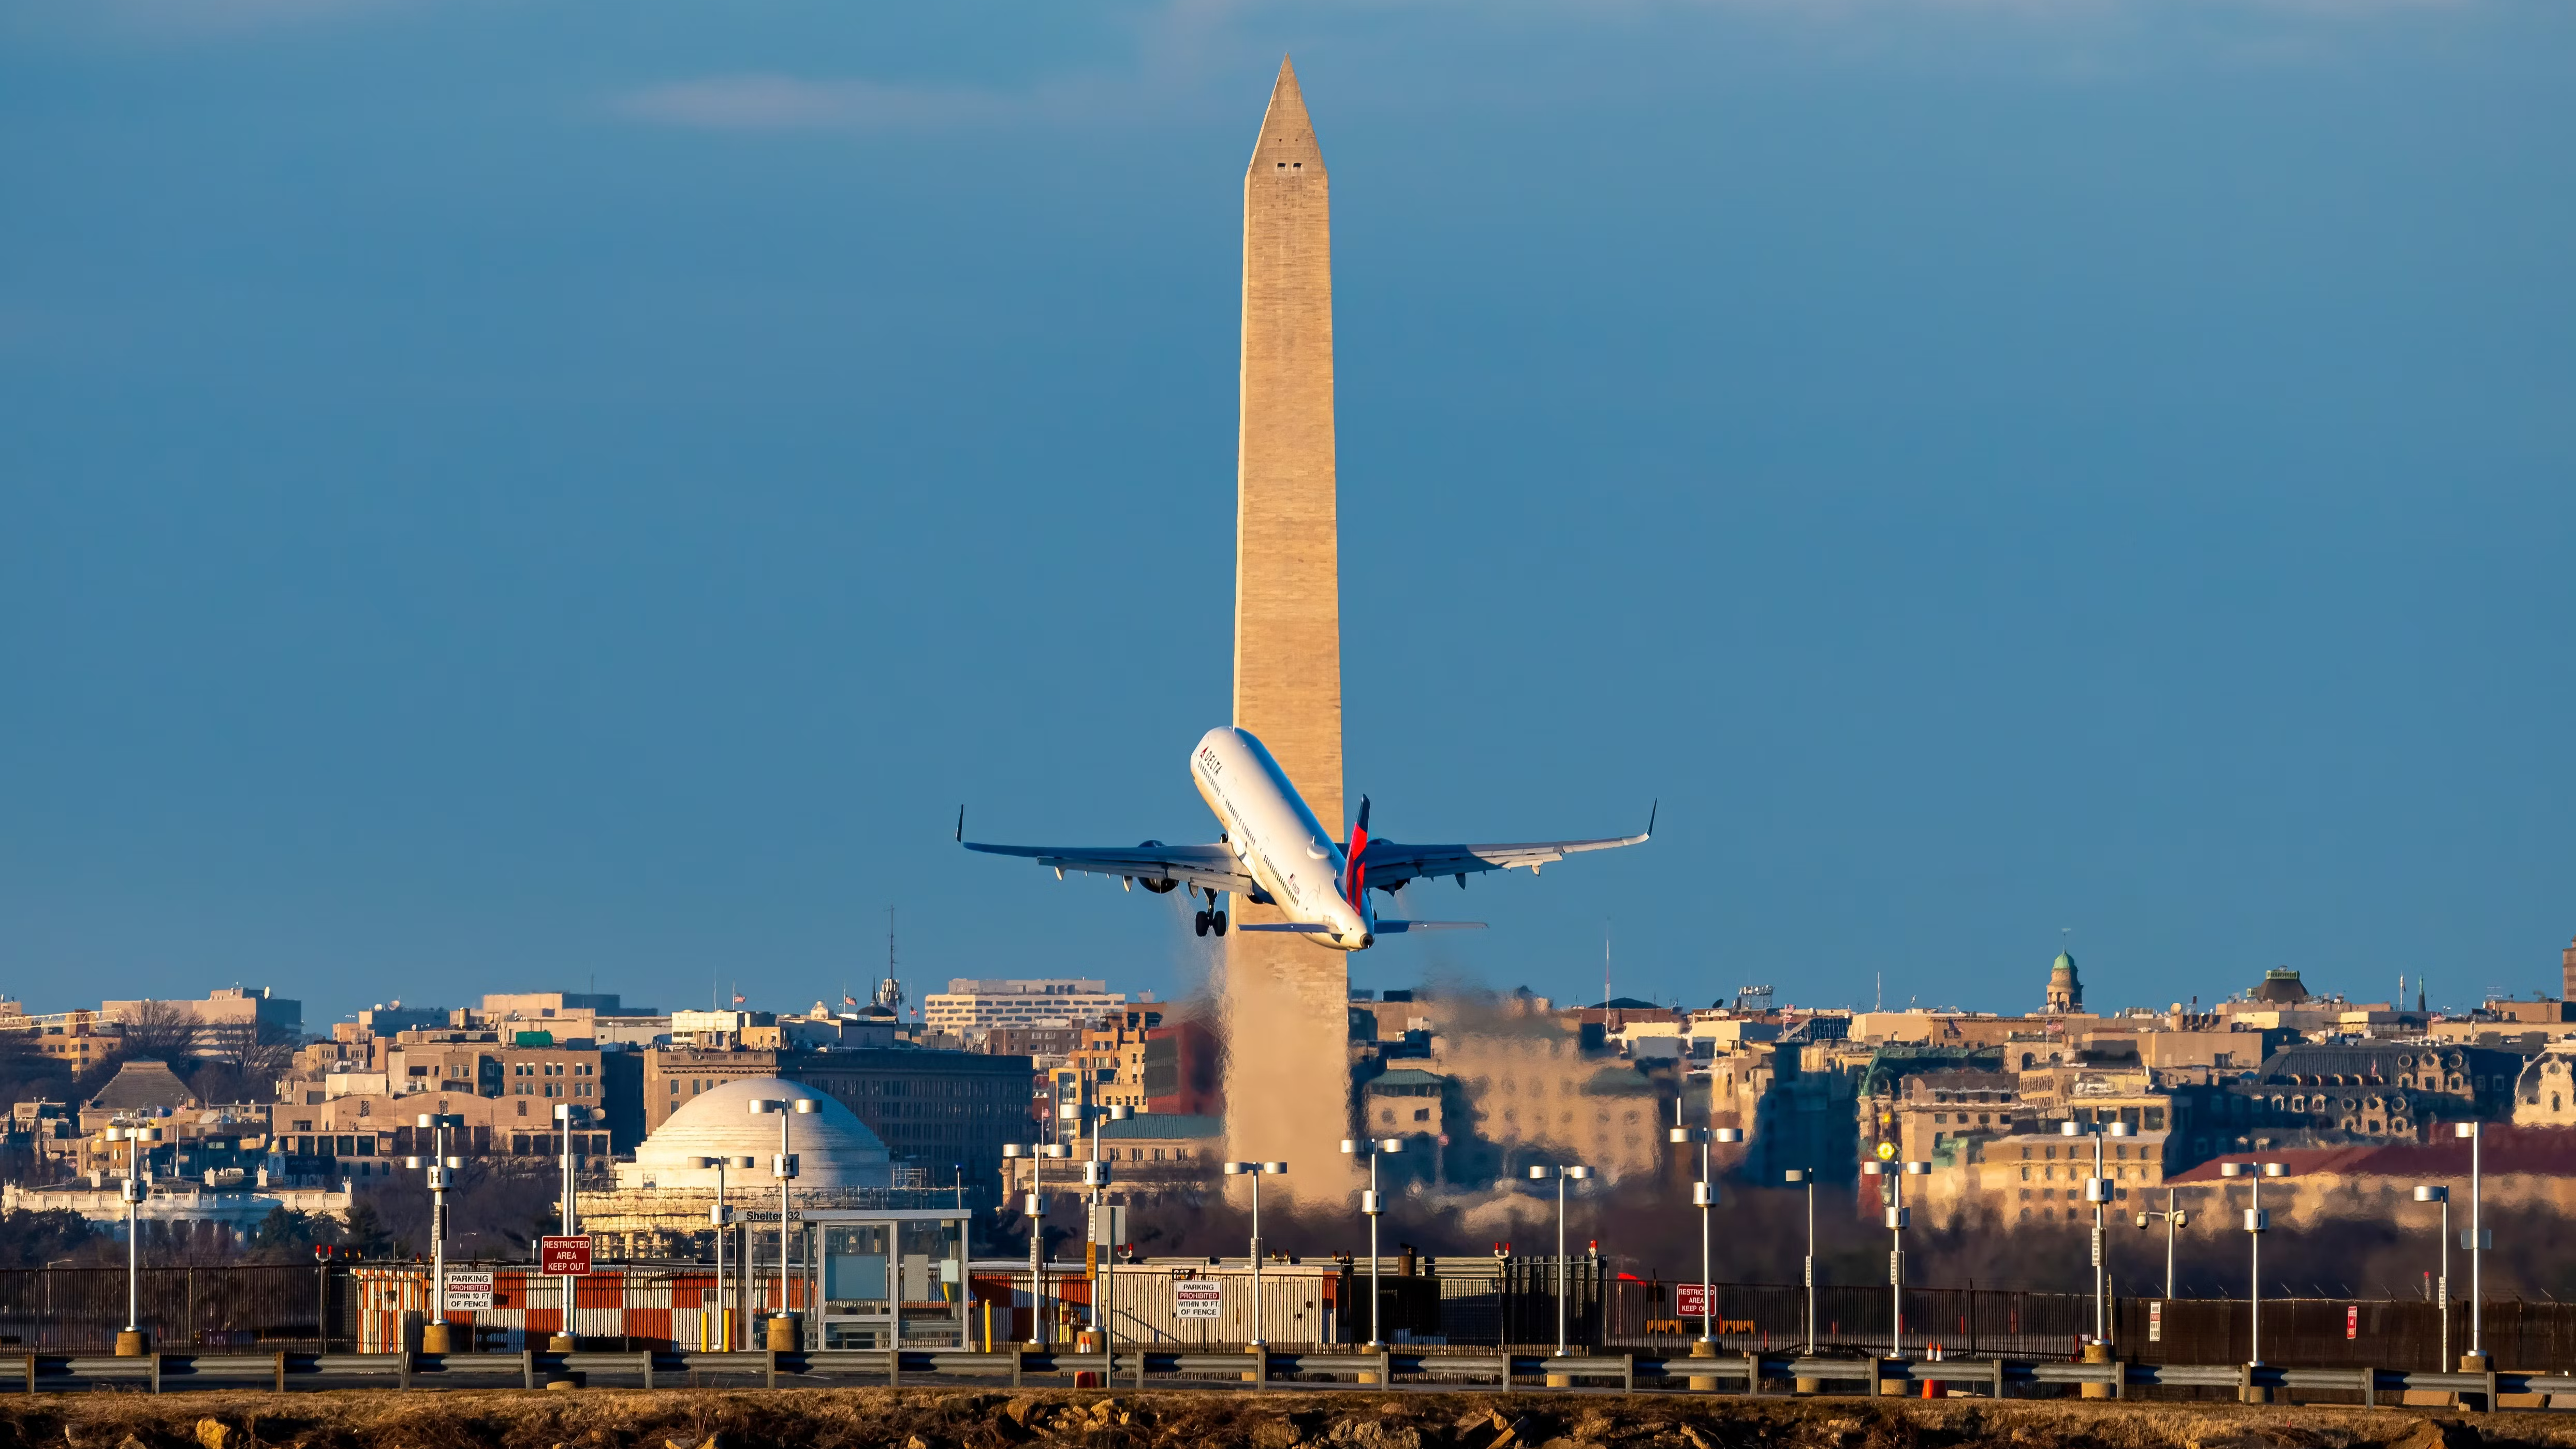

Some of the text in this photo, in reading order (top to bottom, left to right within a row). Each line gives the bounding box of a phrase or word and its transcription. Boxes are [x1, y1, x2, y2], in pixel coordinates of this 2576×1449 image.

[1204, 750, 1222, 777] DELTA
[746, 1211, 800, 1220] Shelter 32
[544, 1240, 590, 1249] RESTRICTED
[557, 1251, 577, 1260] AREA
